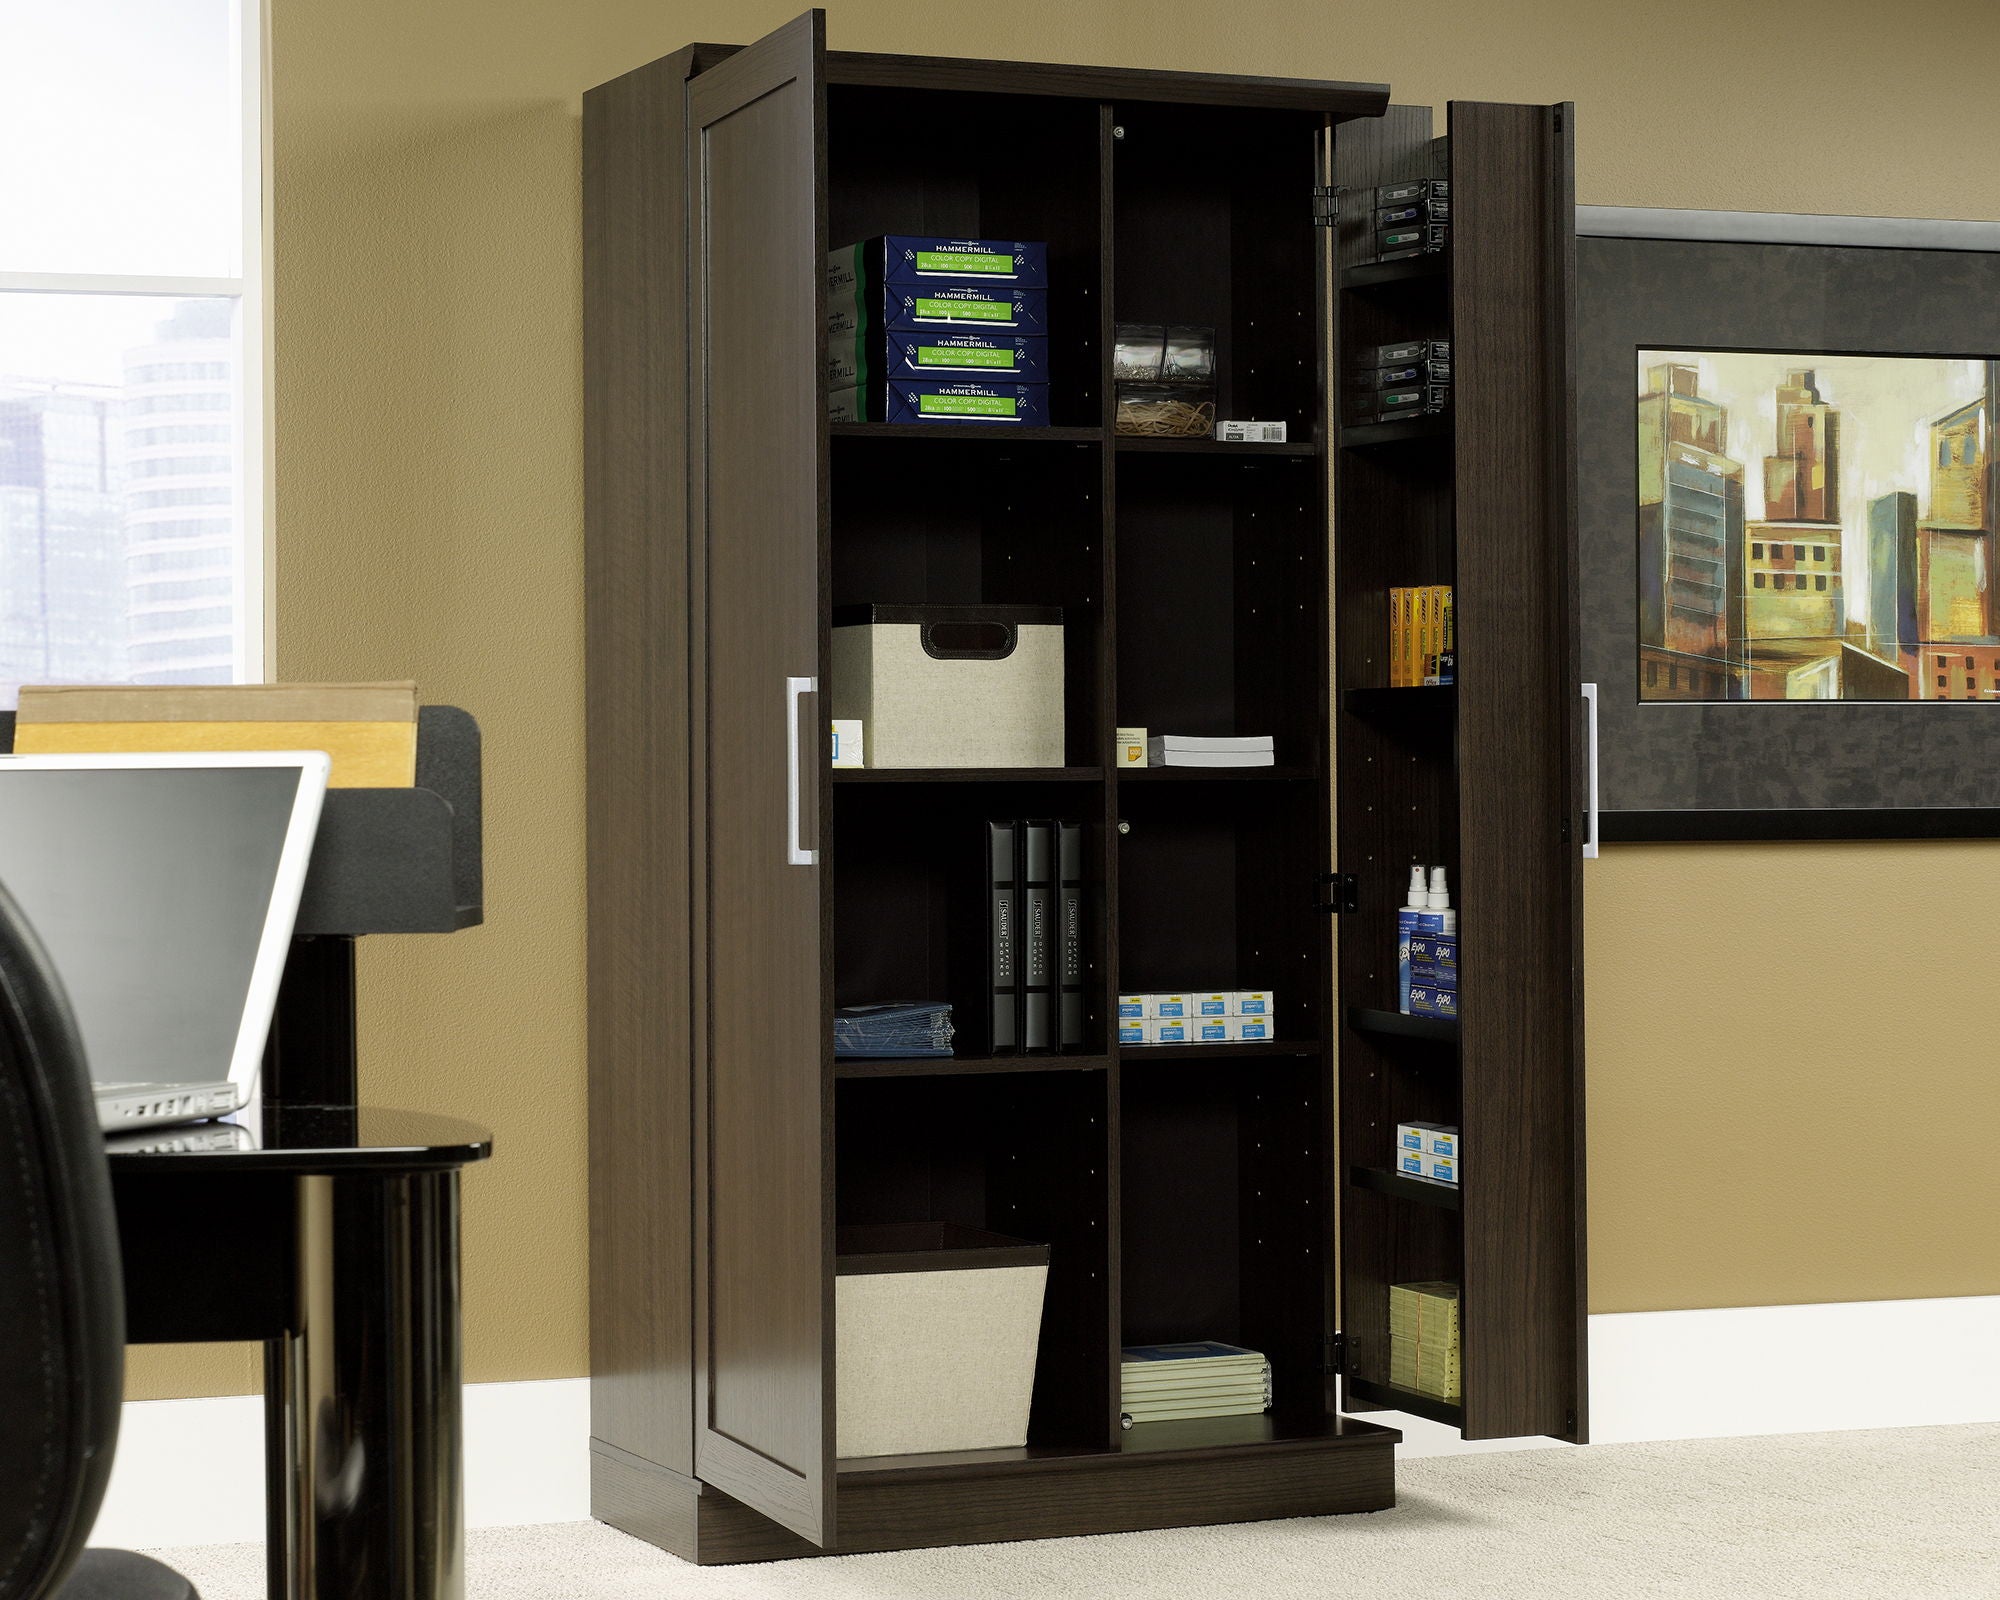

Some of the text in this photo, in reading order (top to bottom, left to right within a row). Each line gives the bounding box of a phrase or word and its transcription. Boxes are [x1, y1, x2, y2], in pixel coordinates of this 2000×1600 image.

[936, 245, 995, 254] HAMMERMILL
[931, 254, 953, 262] COLOR
[935, 292, 994, 301] HAMMERMILL
[938, 340, 996, 348] HAMMERMILL
[939, 388, 998, 396] HAMMERMILL
